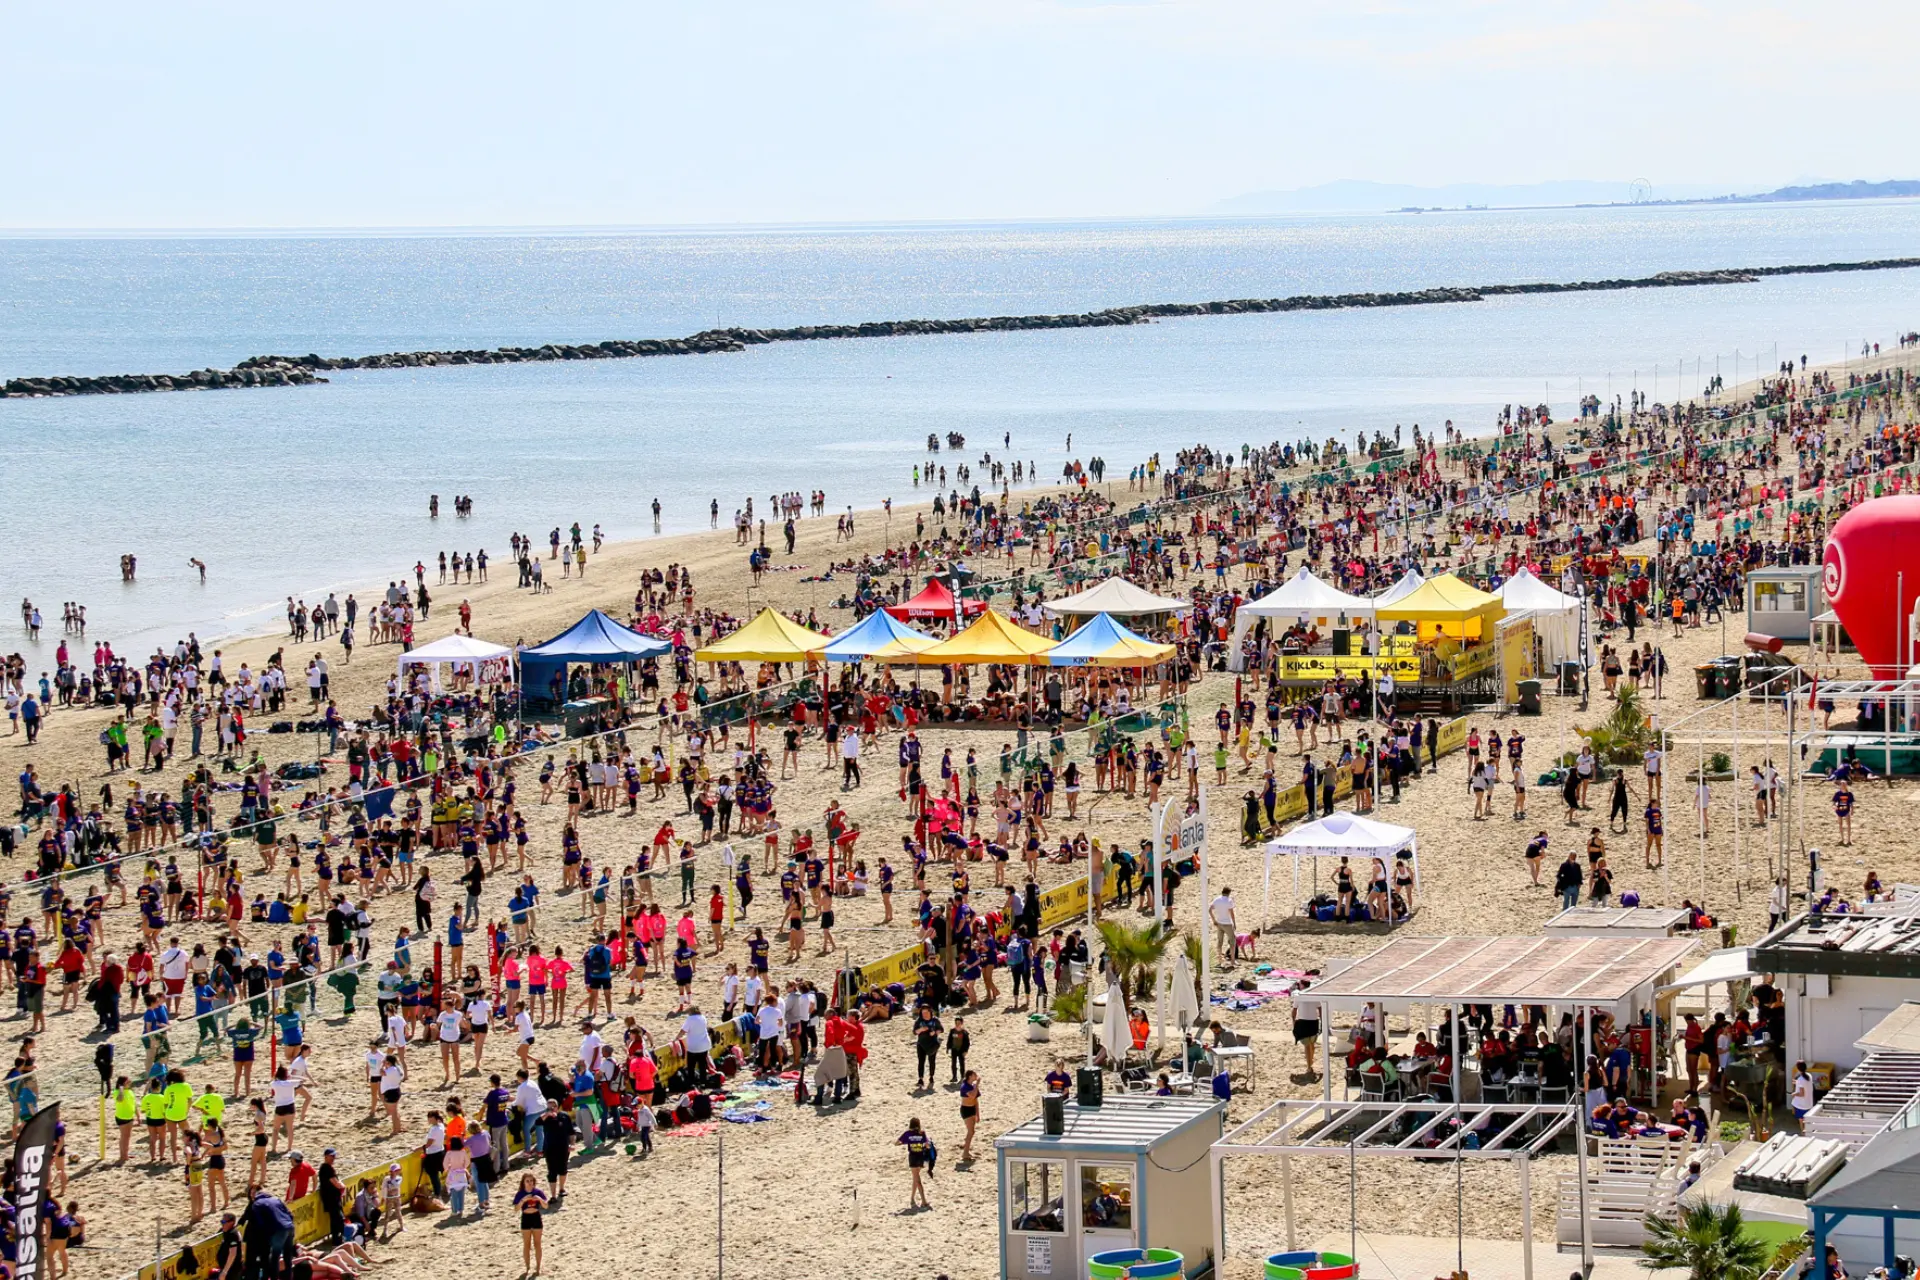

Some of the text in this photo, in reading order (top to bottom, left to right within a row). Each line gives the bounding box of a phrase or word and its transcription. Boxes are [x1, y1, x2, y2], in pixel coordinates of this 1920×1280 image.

[908, 608, 935, 617] Wilson
[1072, 656, 1099, 665] KIKLOS
[1286, 660, 1325, 672] KIKLOS
[1375, 661, 1414, 672] KIKLOS
